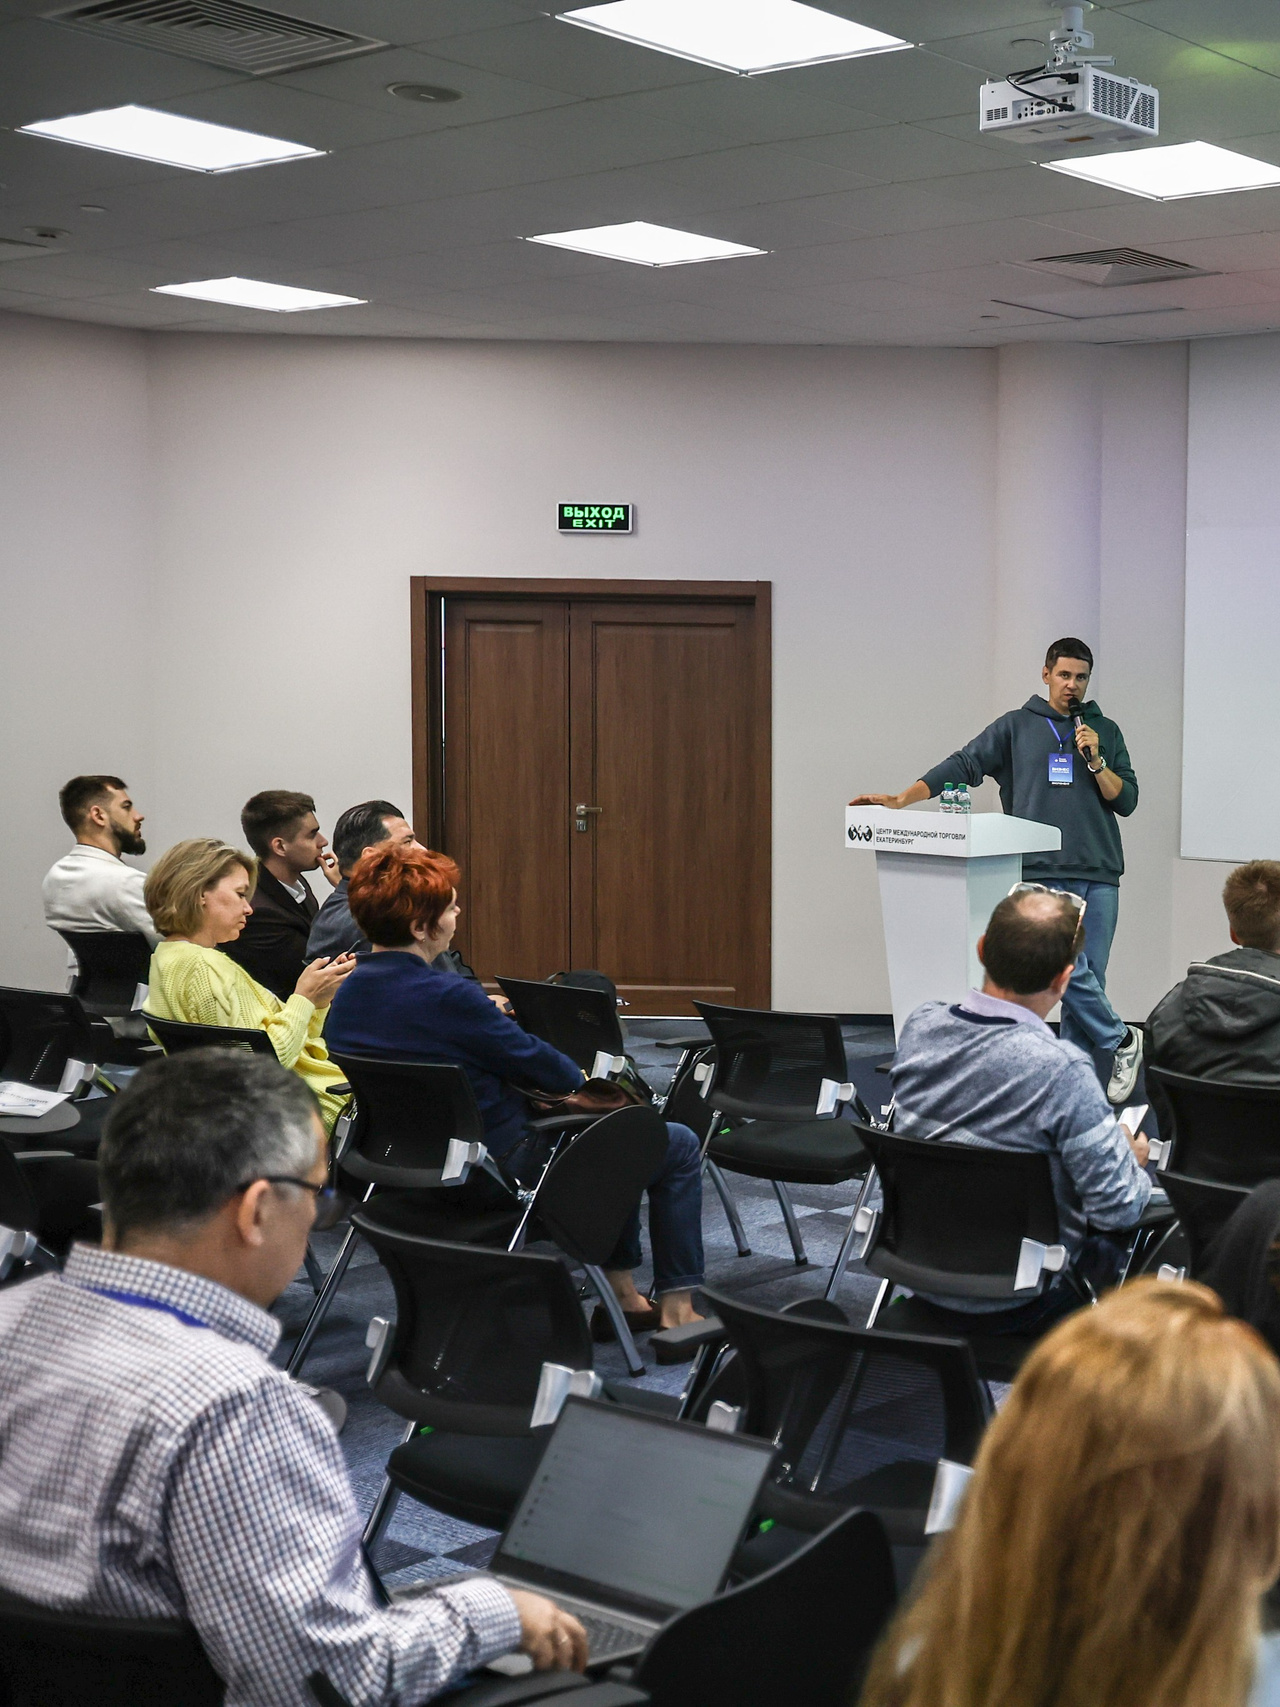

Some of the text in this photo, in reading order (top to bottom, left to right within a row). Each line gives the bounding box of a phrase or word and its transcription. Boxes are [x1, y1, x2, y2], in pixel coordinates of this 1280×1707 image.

[563, 506, 625, 520] ВЫХОД
[572, 519, 616, 528] EXIT
[893, 829, 938, 838] МЕЖДУНАРОДНОЙ
[939, 832, 966, 840] ТОРГОВЛИ
[876, 836, 915, 845] ЕКАТЕРИНБУРГ
